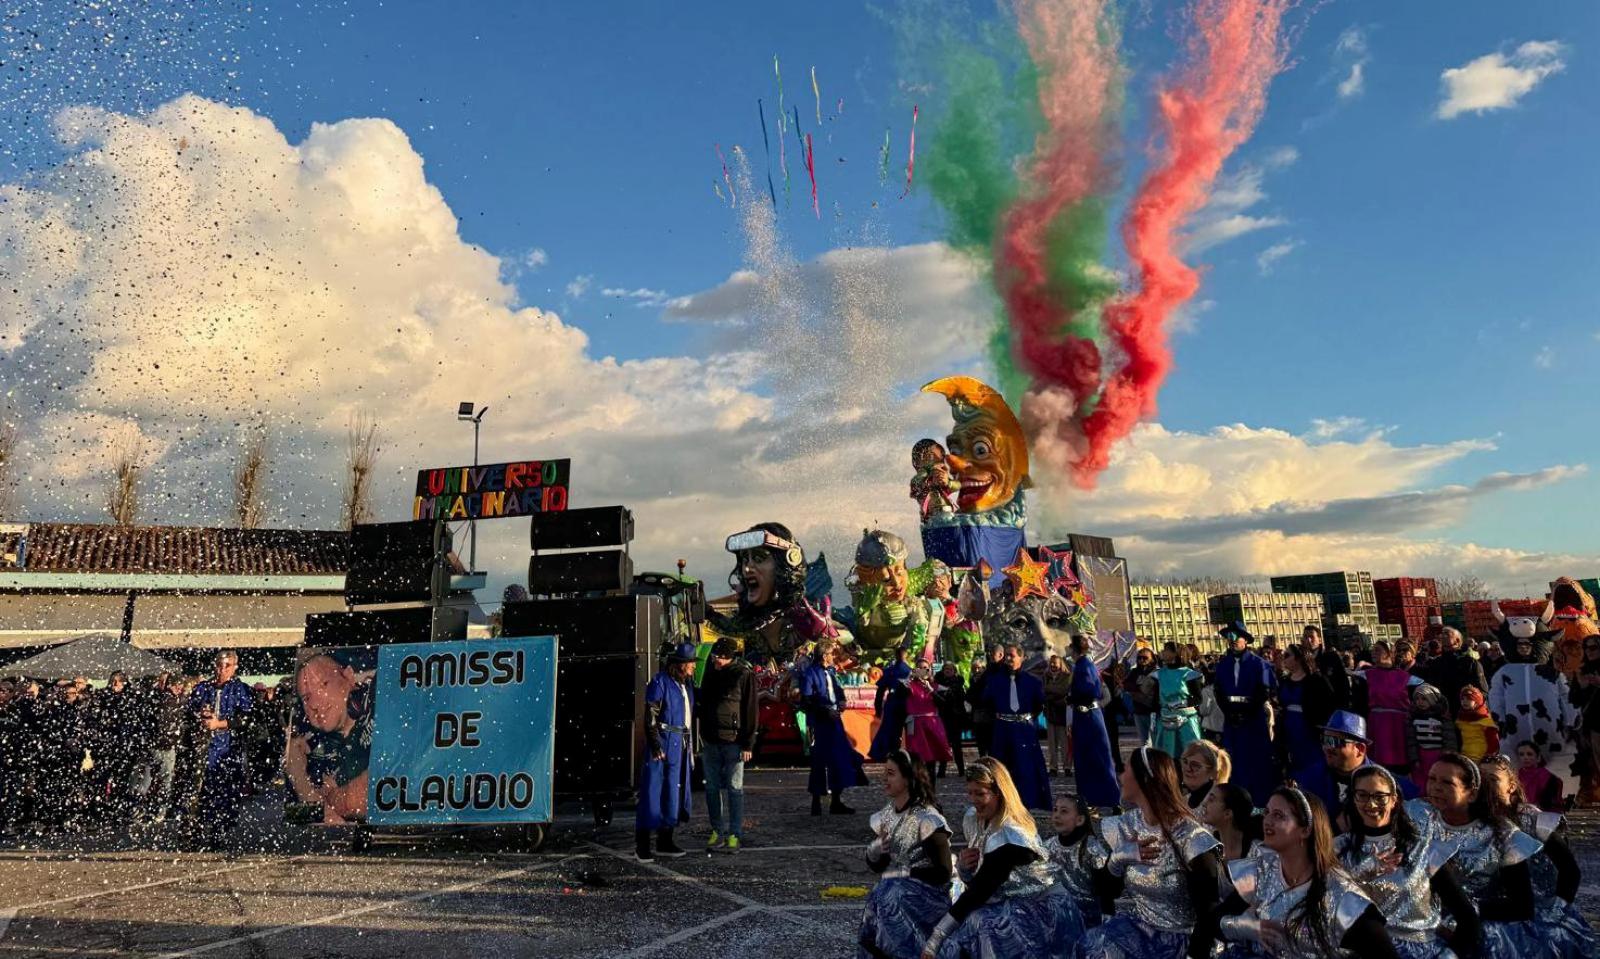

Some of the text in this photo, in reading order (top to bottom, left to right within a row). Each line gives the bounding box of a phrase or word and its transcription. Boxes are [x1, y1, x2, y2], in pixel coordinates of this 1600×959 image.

[428, 461, 557, 496] UNIVERSO
[413, 485, 567, 520] IMMAGINARIO
[400, 650, 524, 689] AMISSI
[433, 711, 483, 748] DE
[375, 772, 534, 812] CLAUDIO
